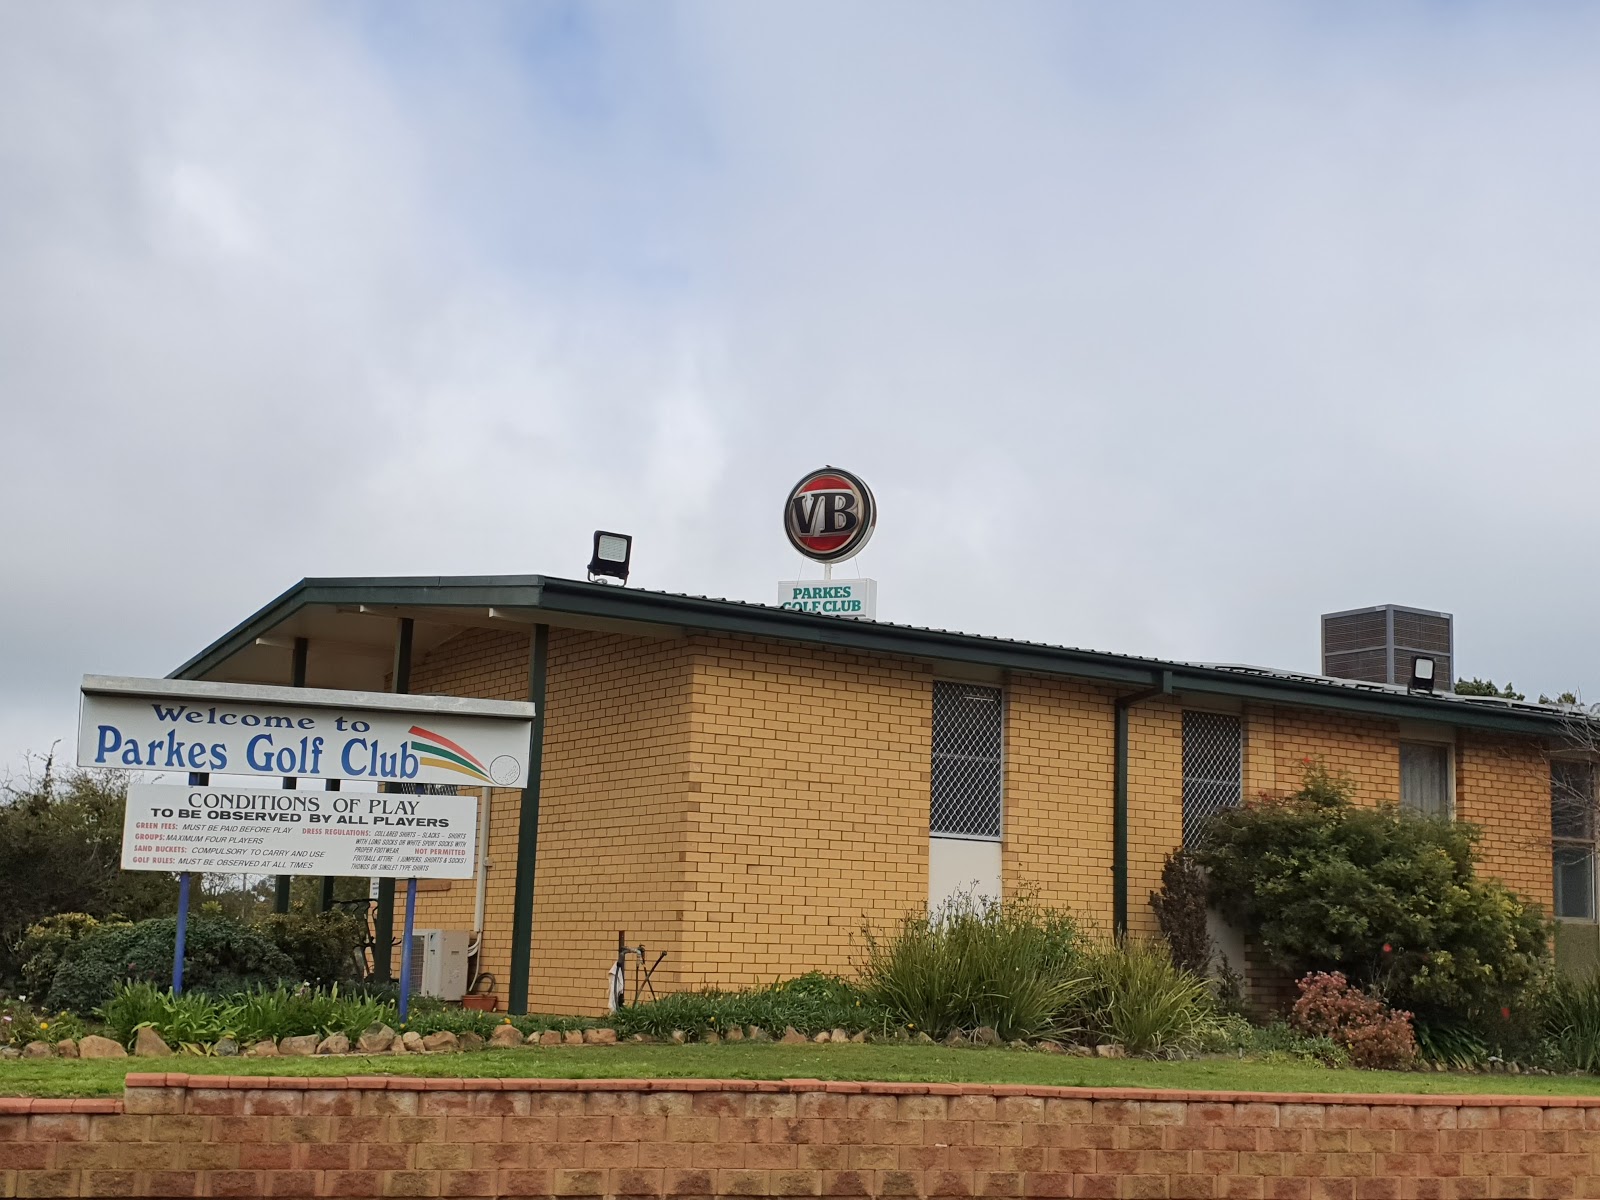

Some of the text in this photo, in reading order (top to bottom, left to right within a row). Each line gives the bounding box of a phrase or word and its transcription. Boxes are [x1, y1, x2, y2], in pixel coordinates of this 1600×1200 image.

[792, 493, 858, 534] VB
[792, 586, 851, 600] PARKES
[822, 600, 862, 612] CLUB
[152, 704, 370, 732] Welcome to
[94, 725, 418, 778] Parkes Golf Club
[188, 793, 420, 816] CONDITIONS OF PLAY
[151, 808, 450, 828] TO BE OBSERVED BY ALL PLAYERS
[324, 828, 371, 836] REGULATIONS:
[192, 847, 248, 855] COMPULSORY
[216, 859, 260, 867] OBSERVED
